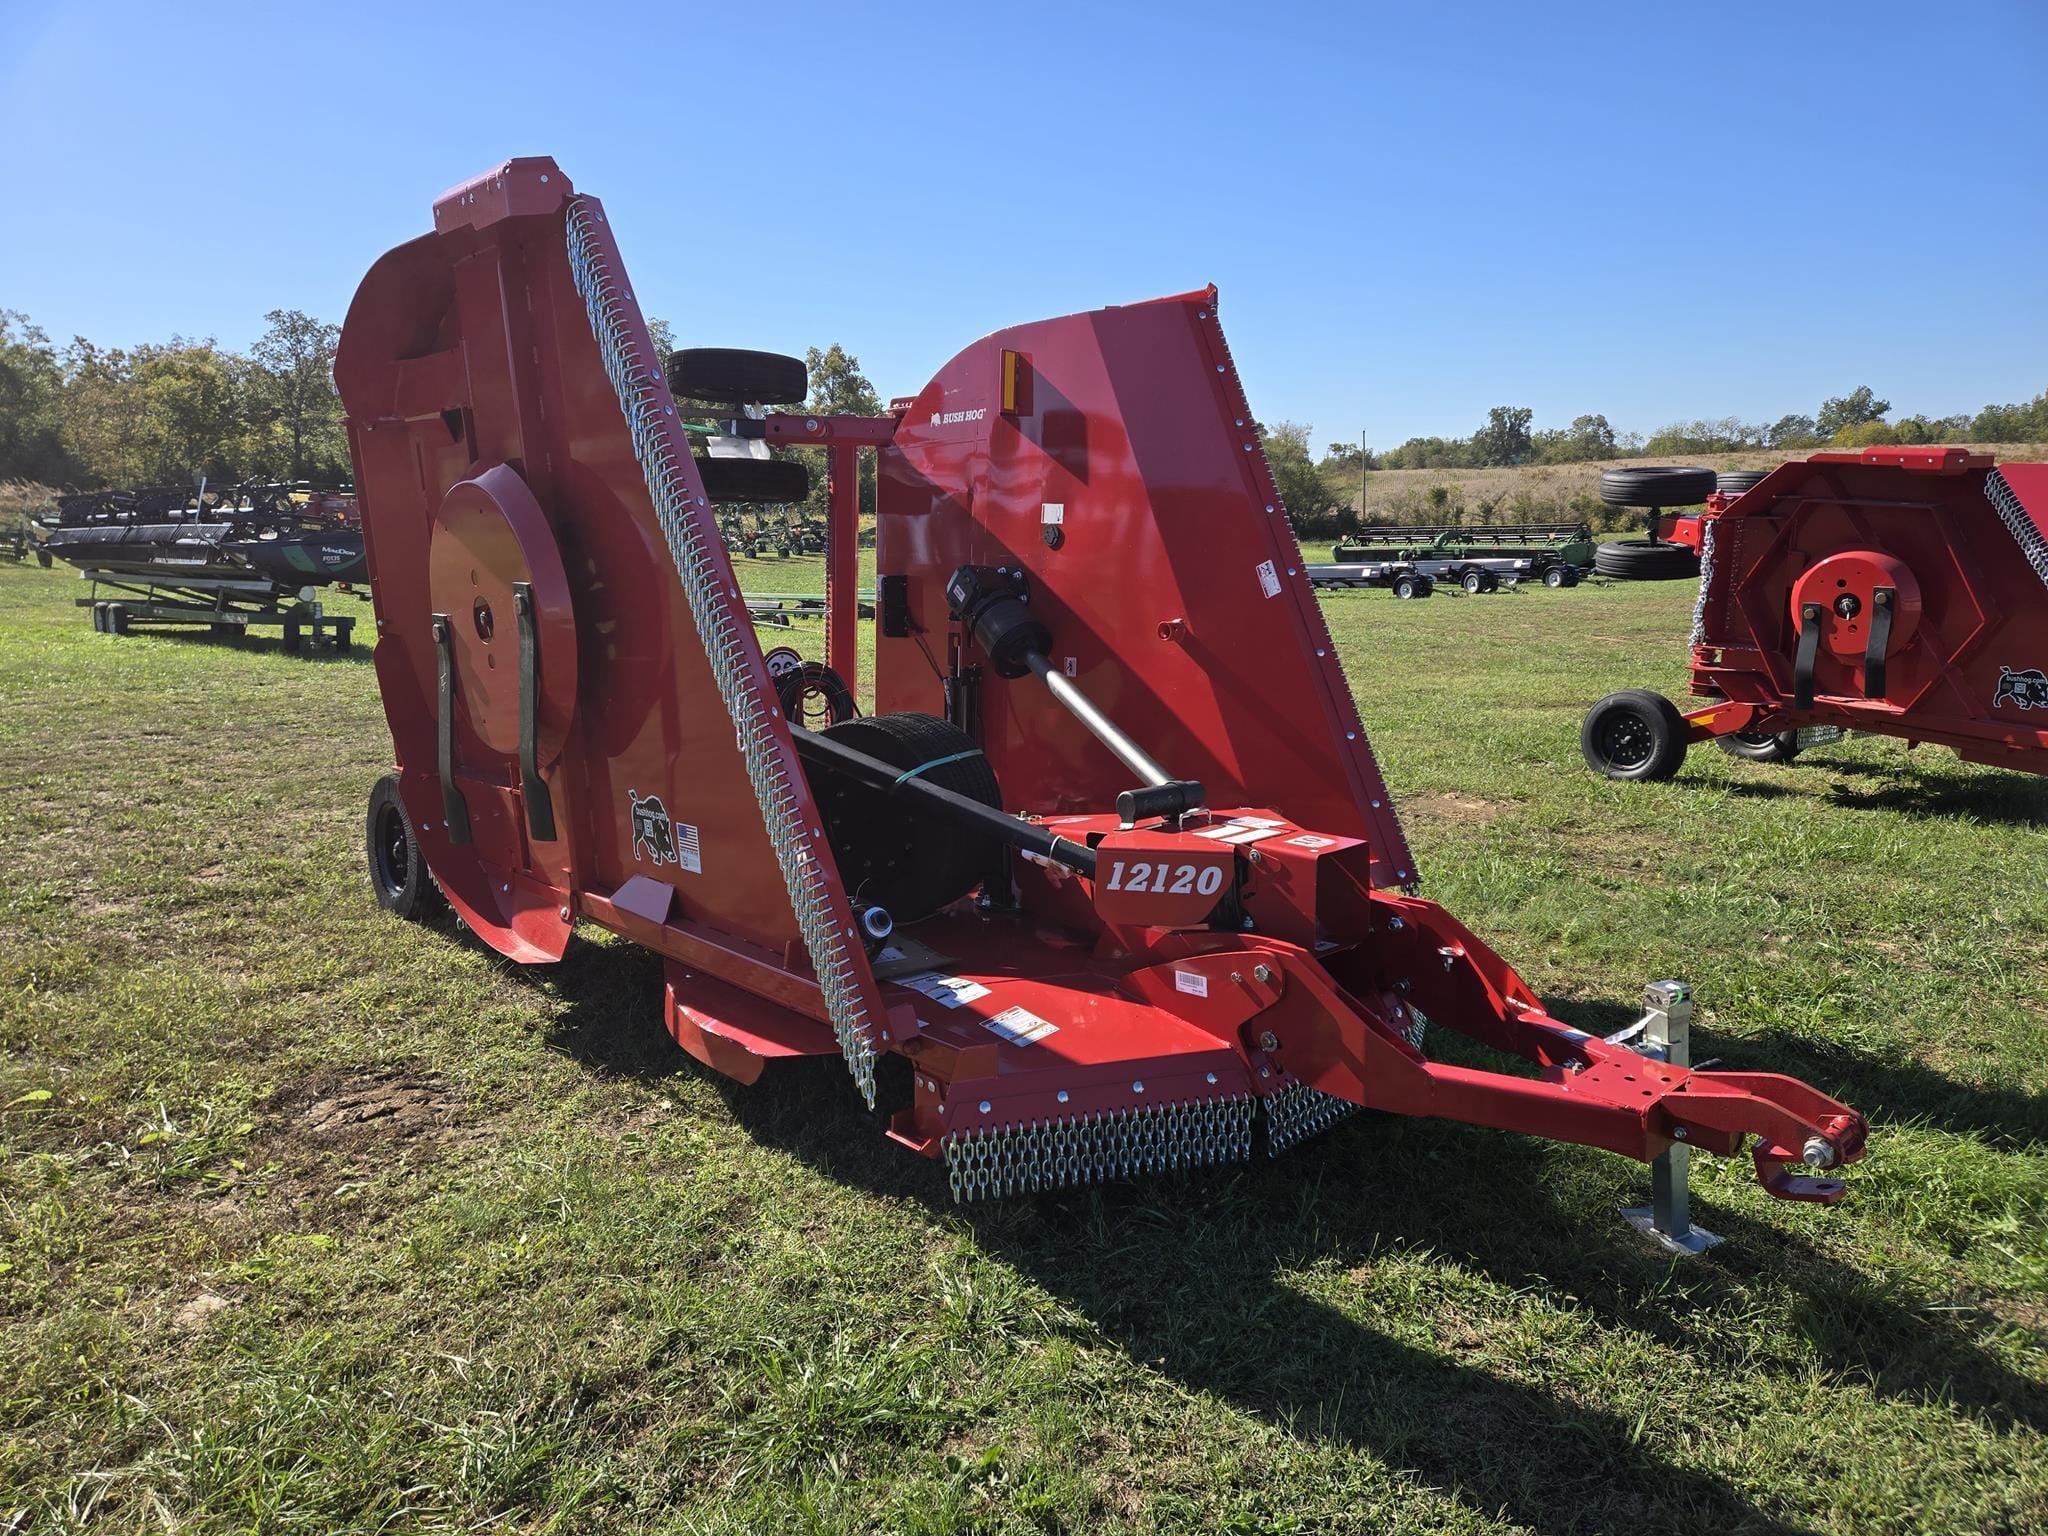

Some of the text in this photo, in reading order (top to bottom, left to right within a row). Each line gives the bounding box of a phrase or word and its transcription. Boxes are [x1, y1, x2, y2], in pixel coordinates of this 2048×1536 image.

[943, 411, 965, 424] BUSH
[321, 546, 356, 556] MacDon
[2006, 675, 2046, 684] bushhog.com
[635, 805, 667, 821] bushhog.com
[1106, 861, 1223, 896] 12120
